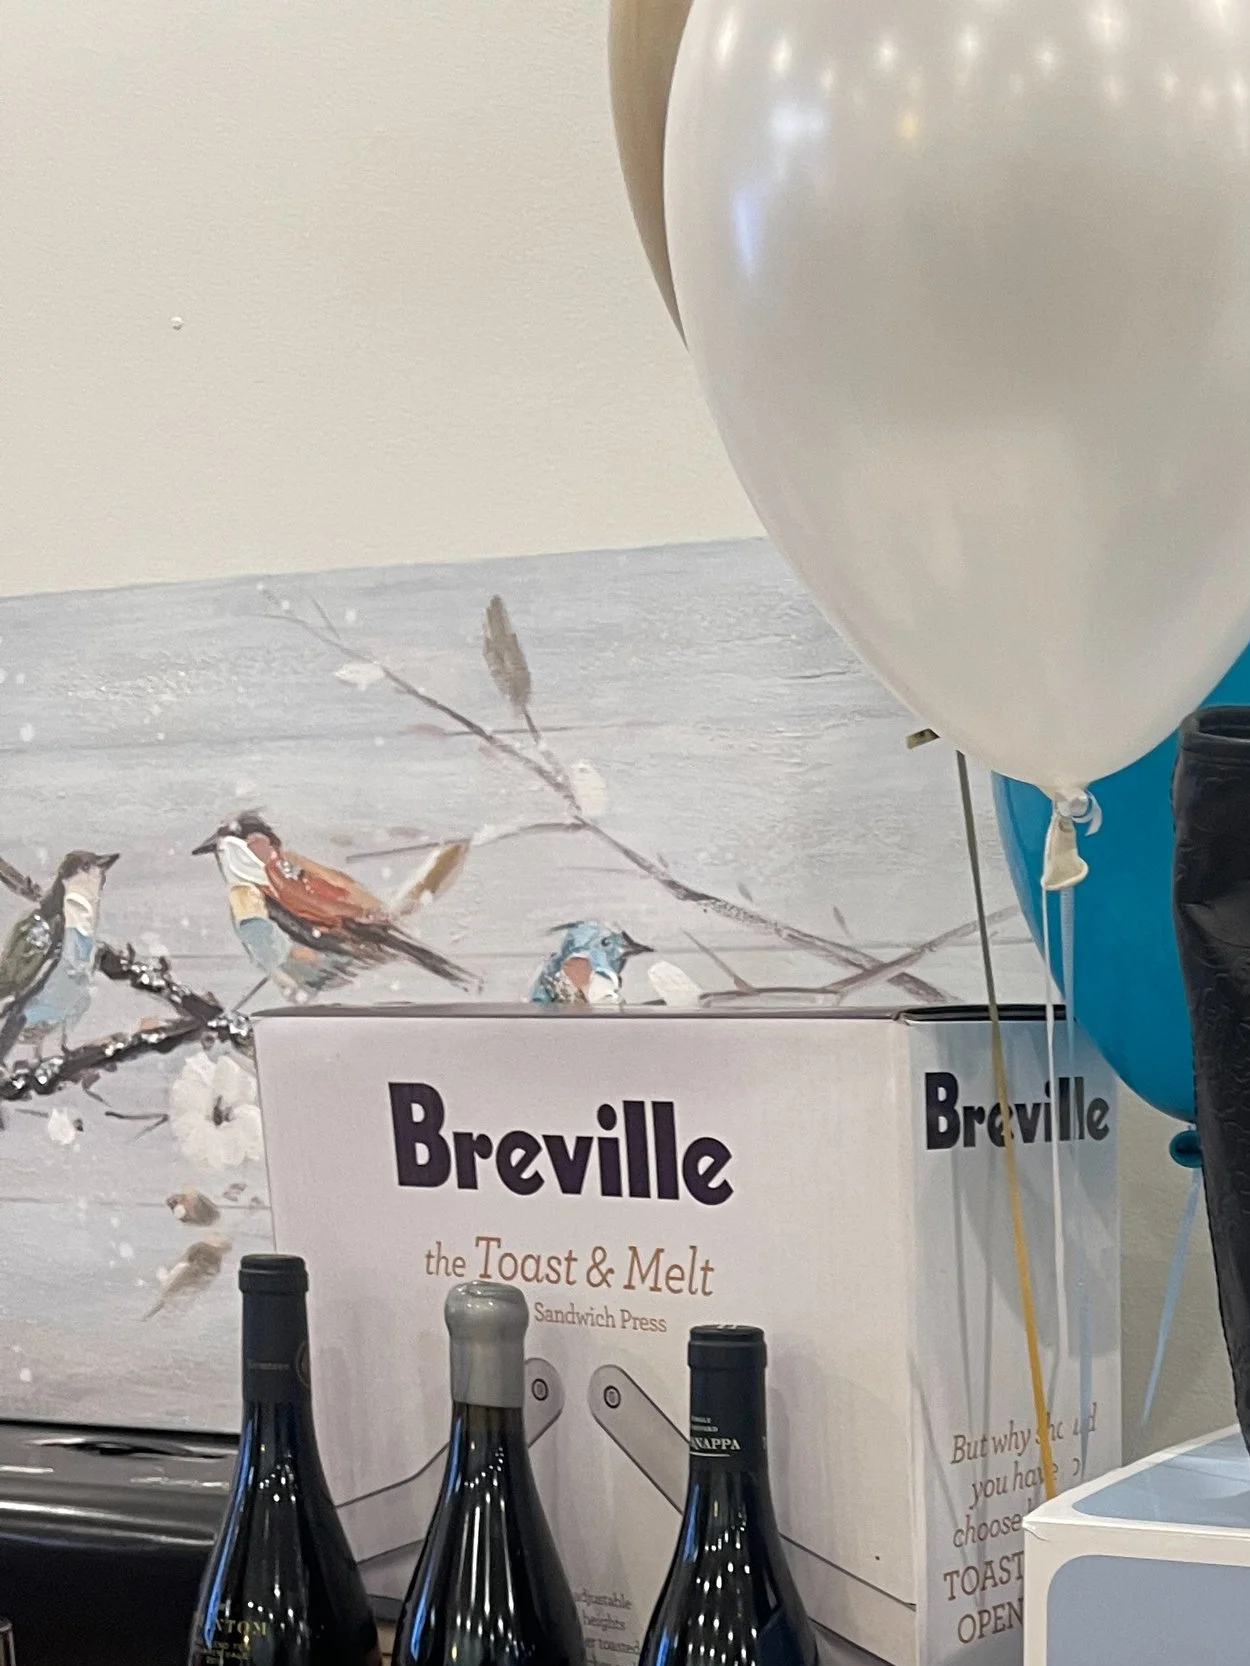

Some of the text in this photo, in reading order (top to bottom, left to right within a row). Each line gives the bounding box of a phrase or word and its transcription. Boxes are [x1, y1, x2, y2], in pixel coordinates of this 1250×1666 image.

[925, 1072, 1111, 1150] Breville
[387, 1081, 735, 1207] Breville
[424, 1237, 716, 1297] the Toast & Melt
[533, 1302, 668, 1333] Sandwich Press
[951, 1434, 989, 1464] But
[991, 1420, 1032, 1456] why
[969, 1477, 1009, 1510] you
[953, 1513, 1023, 1548] choose
